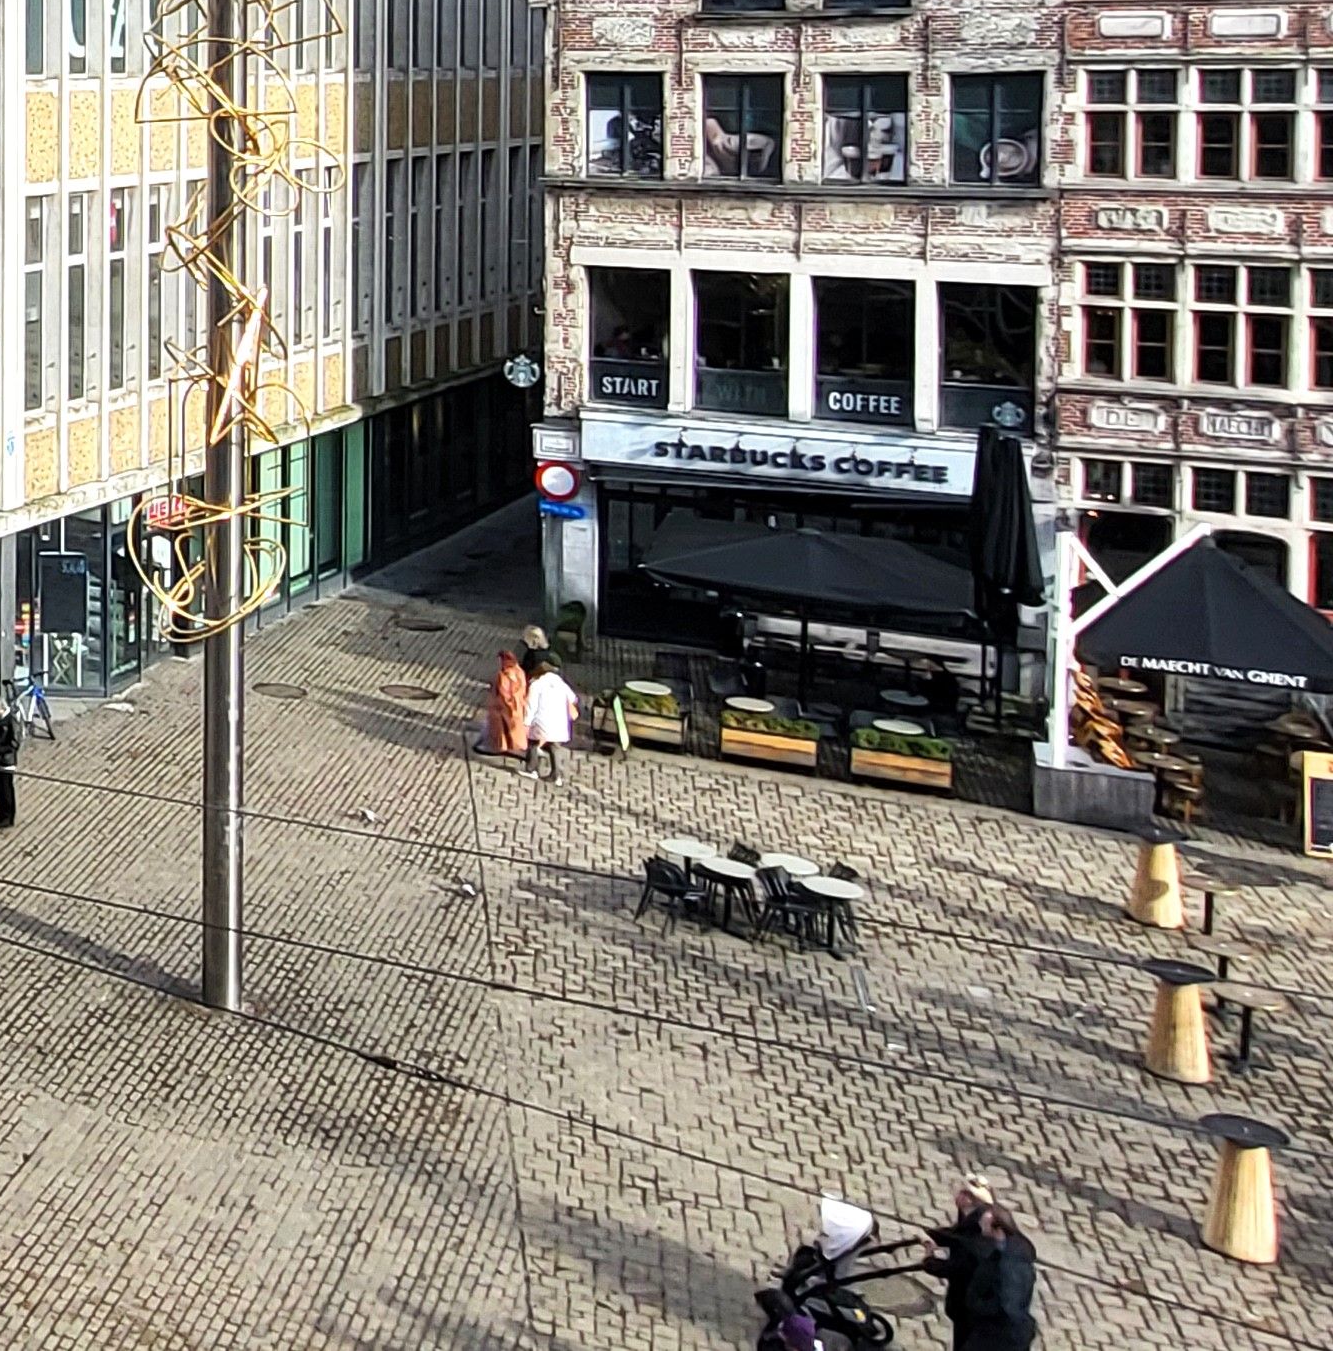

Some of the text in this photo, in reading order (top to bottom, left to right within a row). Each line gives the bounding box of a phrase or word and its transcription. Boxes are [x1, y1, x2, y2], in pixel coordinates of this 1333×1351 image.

[601, 376, 660, 398] START
[828, 391, 902, 415] COFFEE
[1105, 409, 1139, 427] DE
[653, 441, 949, 484] STARBUCKS COFFEE
[1120, 655, 1308, 689] DE MAECHT VAN GHENT
